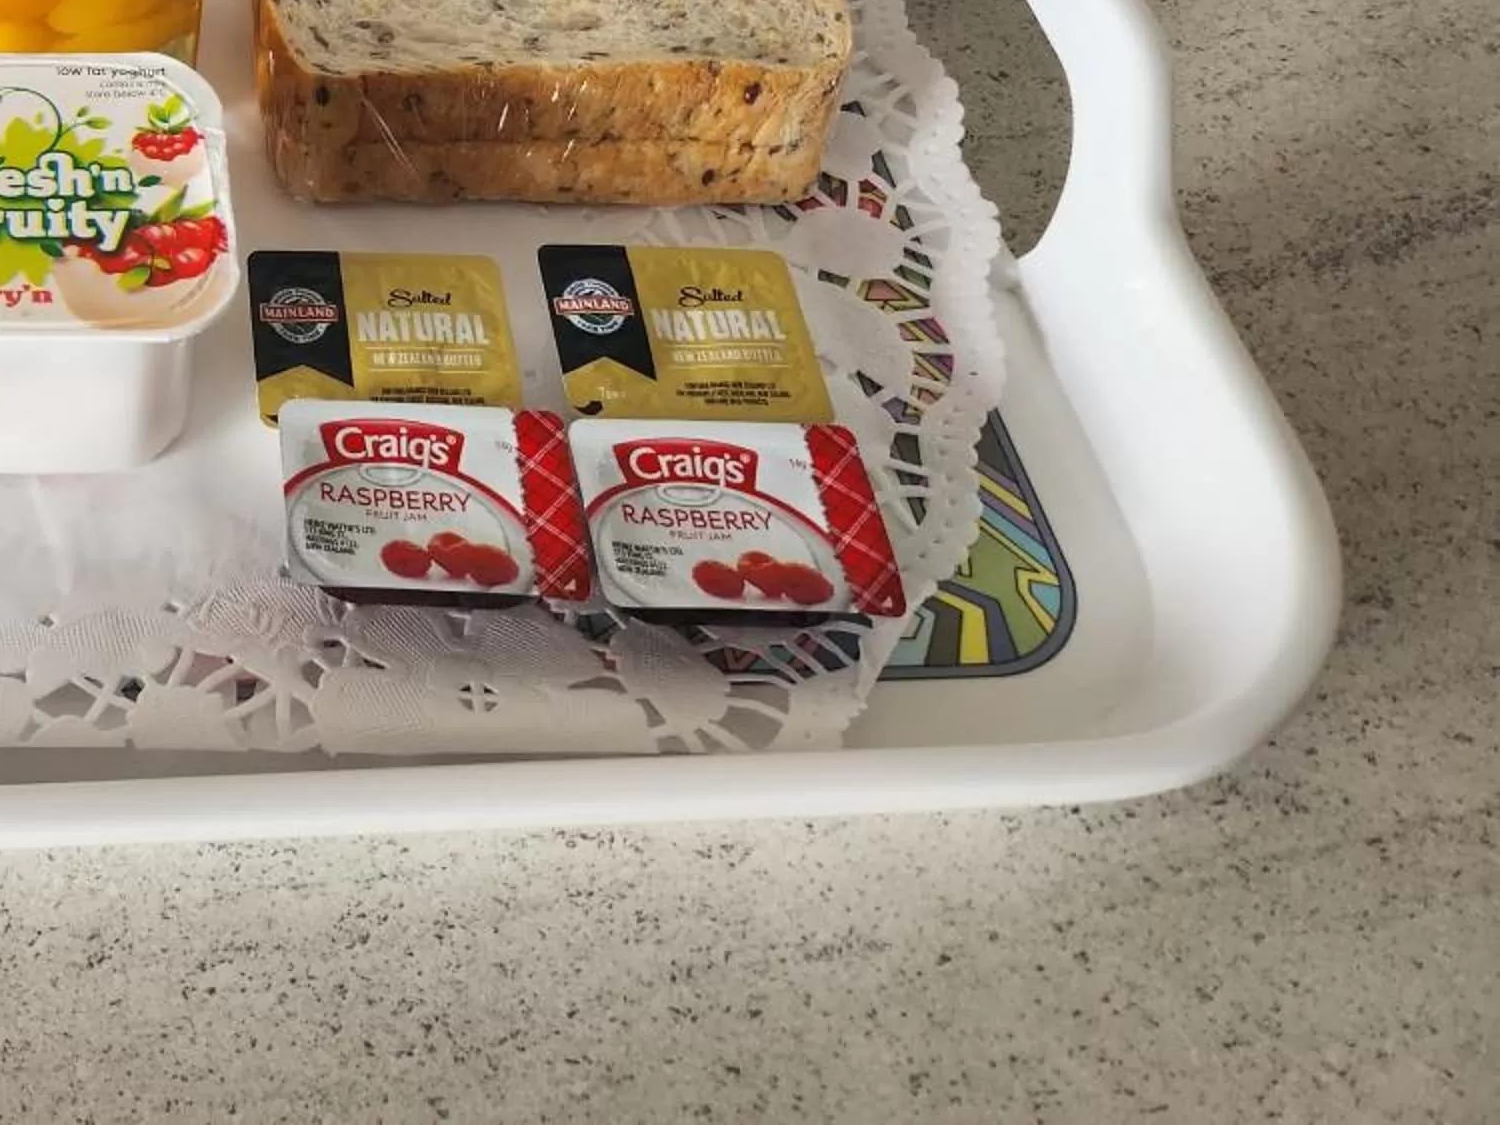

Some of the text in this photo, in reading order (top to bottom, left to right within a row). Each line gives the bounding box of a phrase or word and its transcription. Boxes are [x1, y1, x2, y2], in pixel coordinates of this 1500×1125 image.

[388, 288, 452, 308] Salted
[558, 297, 630, 311] MAINLAND
[678, 285, 744, 308] Salted
[264, 306, 335, 318] MAINLAND
[357, 310, 491, 345] NATURAL
[651, 308, 787, 342] NATURAL
[335, 426, 450, 468] Craig's
[629, 446, 746, 487] Craig's
[320, 482, 472, 512] RASPBERRY
[366, 508, 428, 522] FRUIT JAM
[621, 503, 773, 531] RASPBERRY
[669, 530, 703, 540] FRUIT
